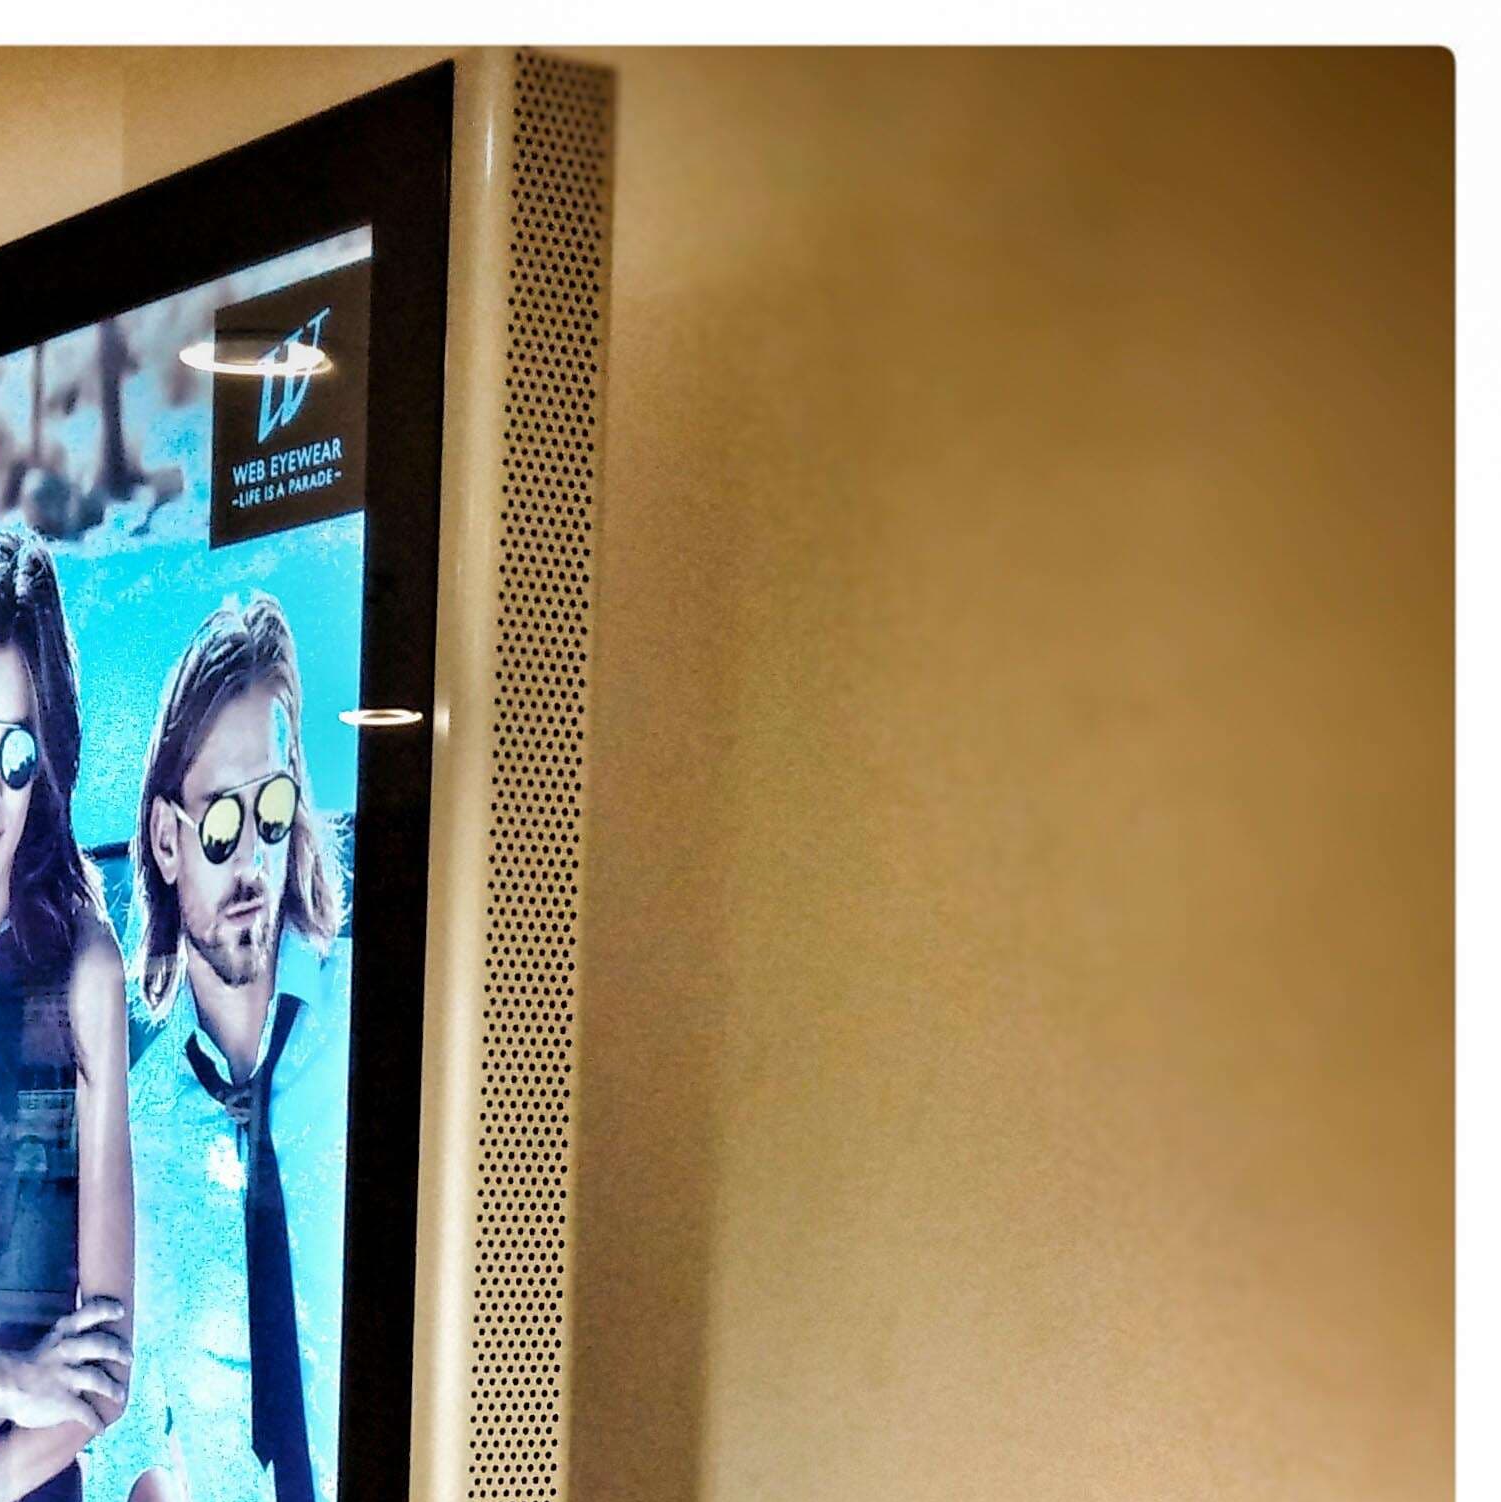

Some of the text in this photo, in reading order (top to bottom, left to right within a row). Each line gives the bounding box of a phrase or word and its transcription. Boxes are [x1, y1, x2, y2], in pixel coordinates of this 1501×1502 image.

[233, 437, 342, 487] WEB EYEWEAR
[264, 484, 275, 501] IS
[276, 482, 285, 498] A
